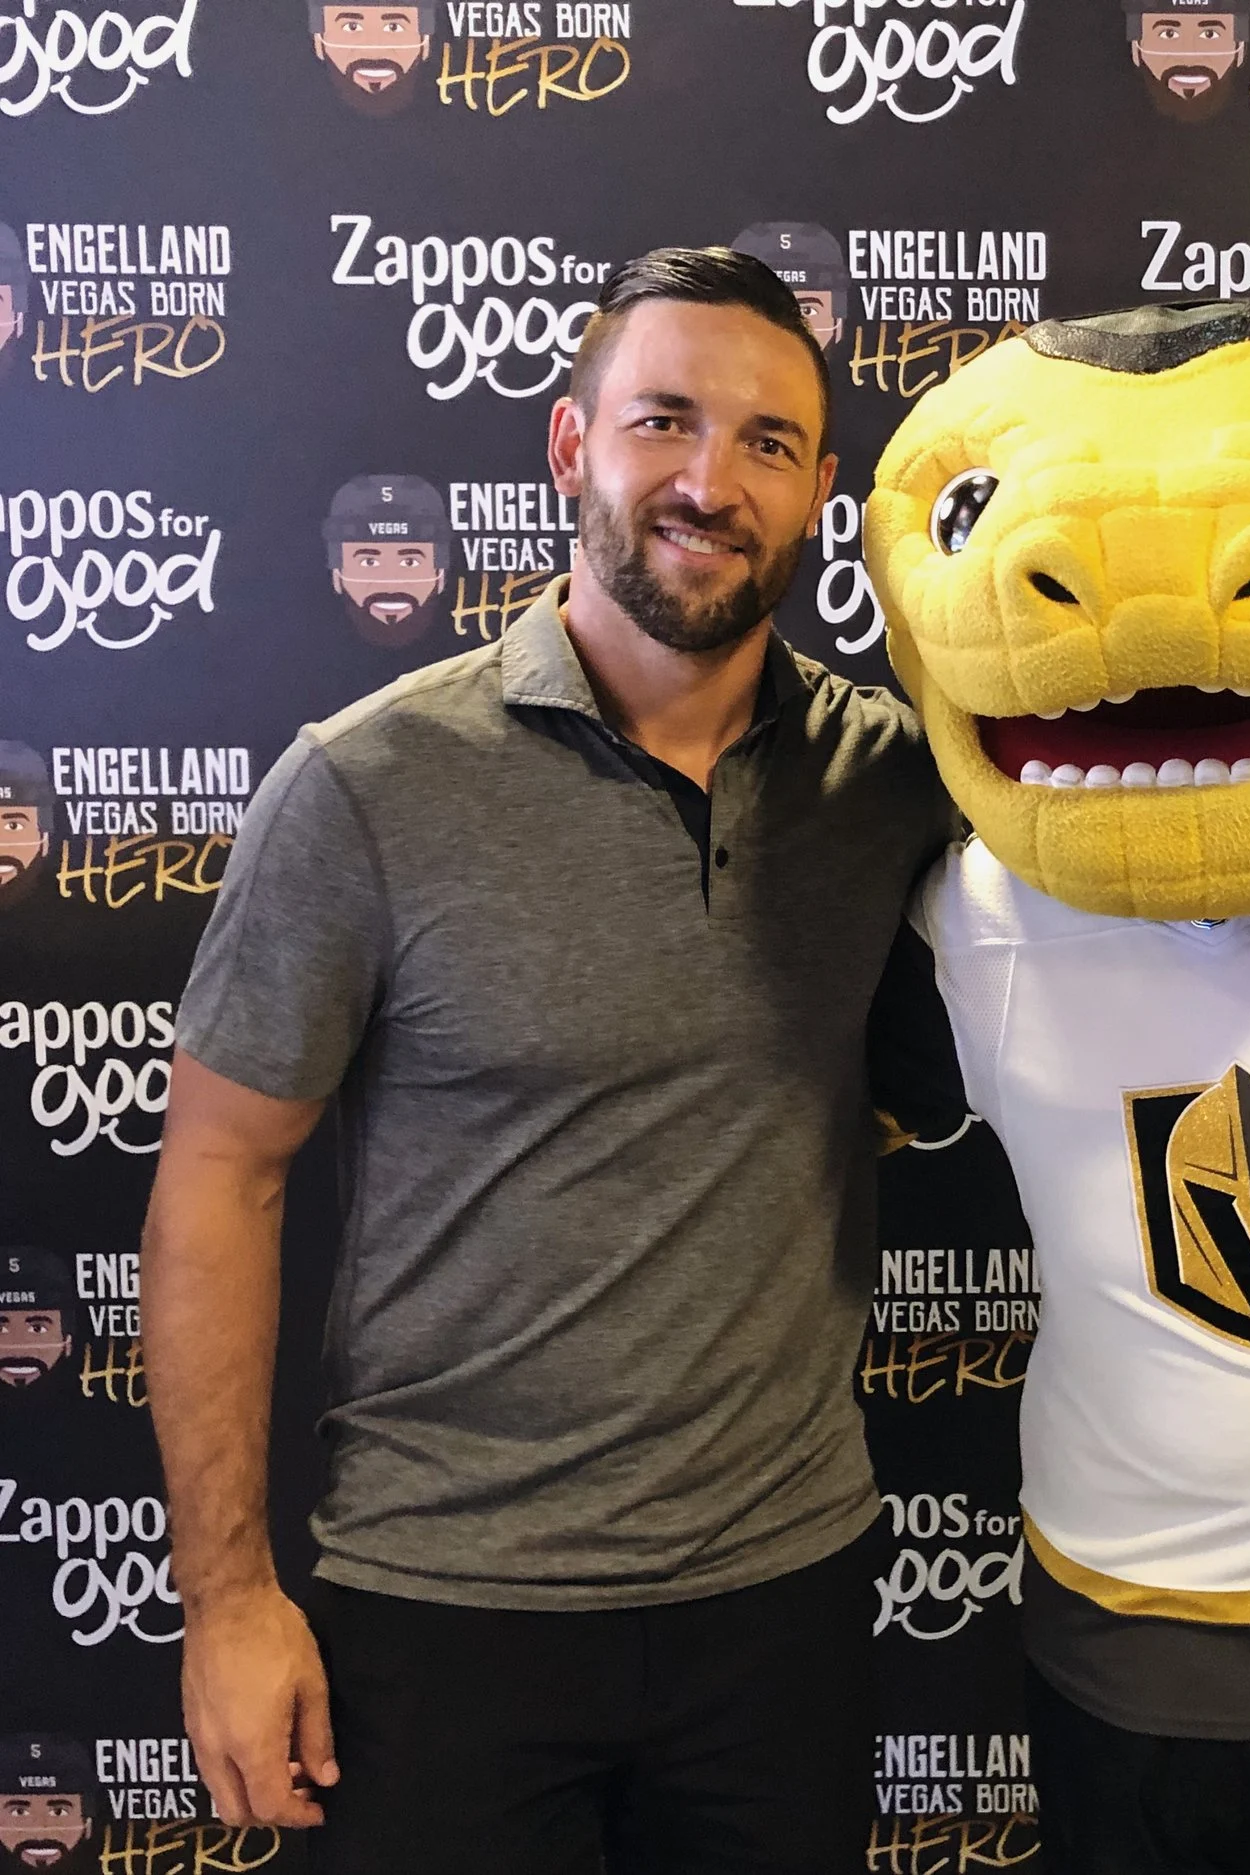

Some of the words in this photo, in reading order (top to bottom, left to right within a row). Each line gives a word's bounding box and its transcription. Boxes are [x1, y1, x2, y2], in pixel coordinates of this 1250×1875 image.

[449, 3, 540, 37] VEGAS
[557, 4, 630, 38] BORN
[437, 35, 630, 116] HERO
[808, 0, 1025, 124] good
[26, 223, 231, 275] ENGELLAND
[330, 215, 557, 305] Zappos
[560, 255, 611, 284] for
[849, 230, 1047, 281] ENGELLAND
[40, 280, 136, 315] VEGAS
[151, 282, 226, 316] BORN
[861, 286, 952, 321] VEGAS
[967, 287, 1039, 321] BORN
[31, 313, 226, 393] HERO
[382, 487, 392, 502] 5
[450, 483, 575, 531] ENGELL
[159, 508, 209, 536] for
[369, 522, 408, 535] VEGAS
[462, 537, 554, 571] VEGAS
[6, 529, 221, 651] good
[53, 748, 250, 795] ENGELLAND
[66, 802, 158, 834] VEGAS
[172, 802, 246, 834] BORN
[0, 1001, 174, 1066] appos
[872, 1301, 960, 1333] VEGAS
[975, 1301, 1041, 1332] BORN
[974, 1511, 1021, 1536] for
[109, 1789, 196, 1819] VEGAS
[876, 1785, 962, 1814] VEGAS
